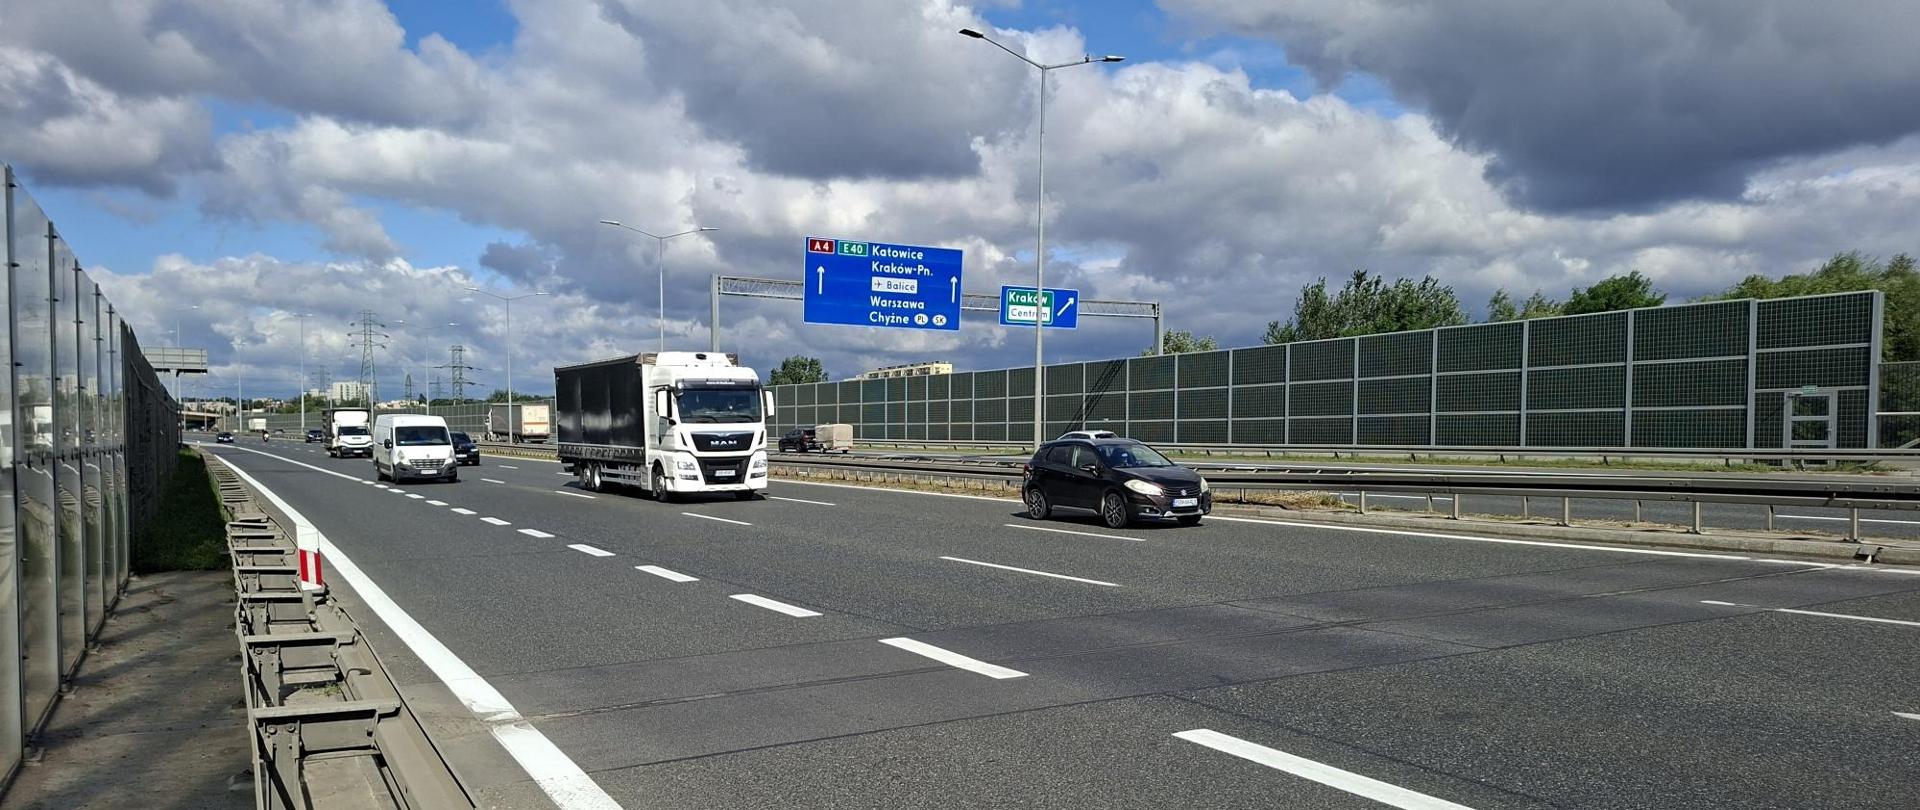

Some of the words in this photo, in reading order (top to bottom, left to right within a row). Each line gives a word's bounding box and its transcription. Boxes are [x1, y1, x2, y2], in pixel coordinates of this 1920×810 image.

[872, 245, 924, 260] Katowice
[871, 261, 933, 277] Kraków-Pn.
[886, 280, 915, 291] Balice
[870, 295, 925, 310] Warszawa
[869, 311, 910, 326] Chyżne
[917, 315, 926, 323] PL
[935, 316, 944, 324] SK
[1010, 308, 1048, 319] Centrm
